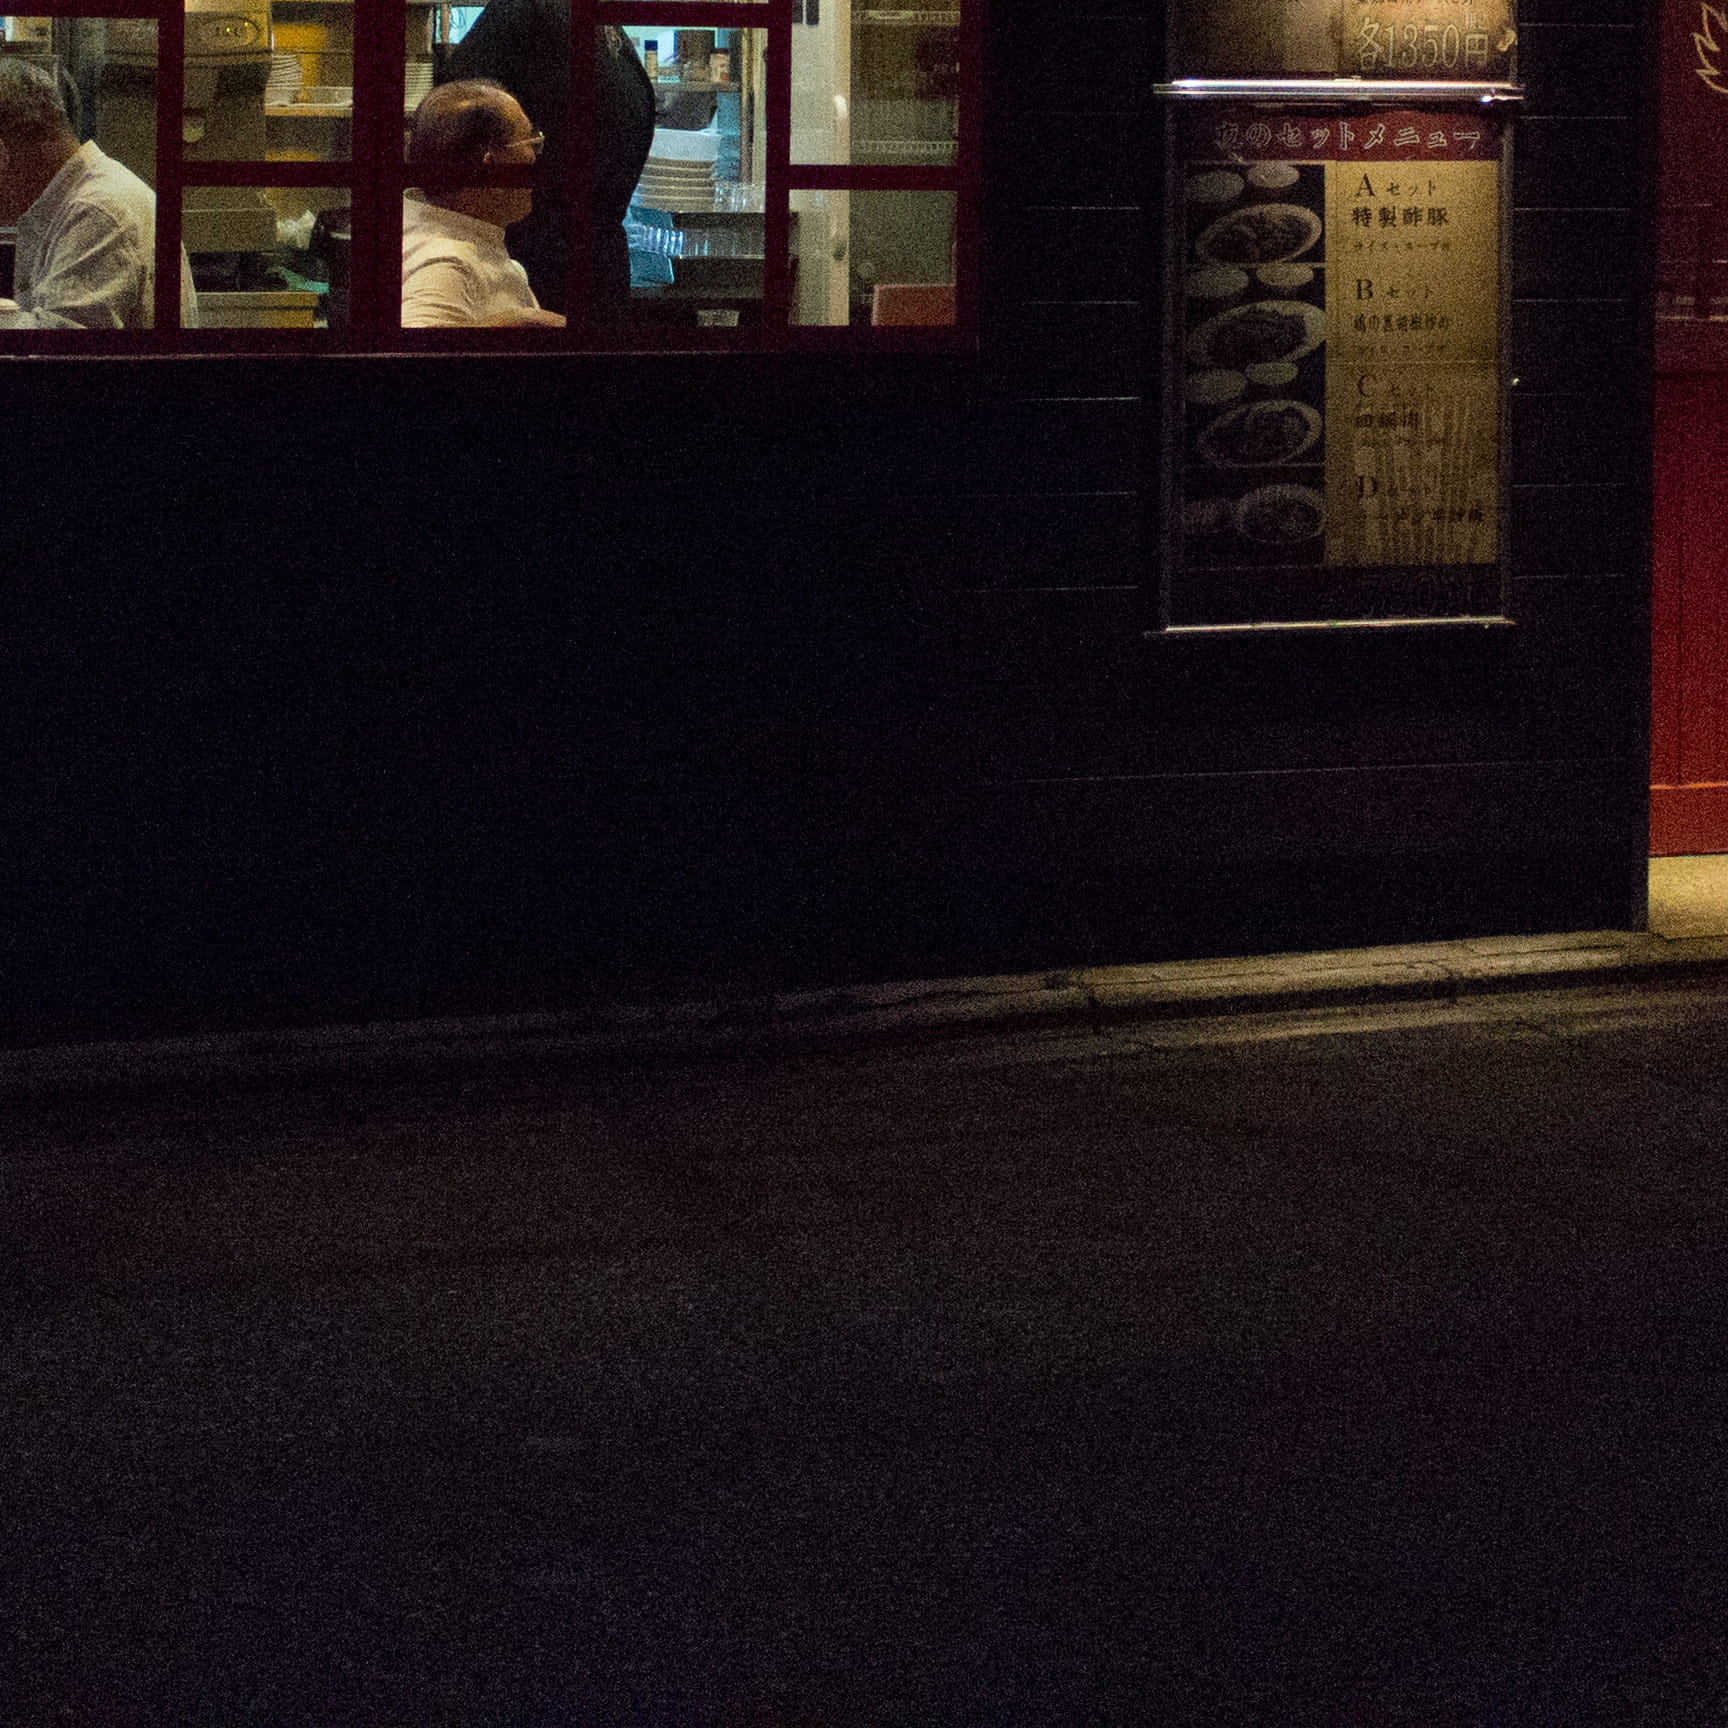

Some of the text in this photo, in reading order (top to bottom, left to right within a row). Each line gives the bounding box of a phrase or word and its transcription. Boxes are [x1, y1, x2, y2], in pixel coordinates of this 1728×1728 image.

[1358, 17, 1489, 71] 各1350円
[1356, 173, 1375, 197] A
[1356, 278, 1374, 301] B
